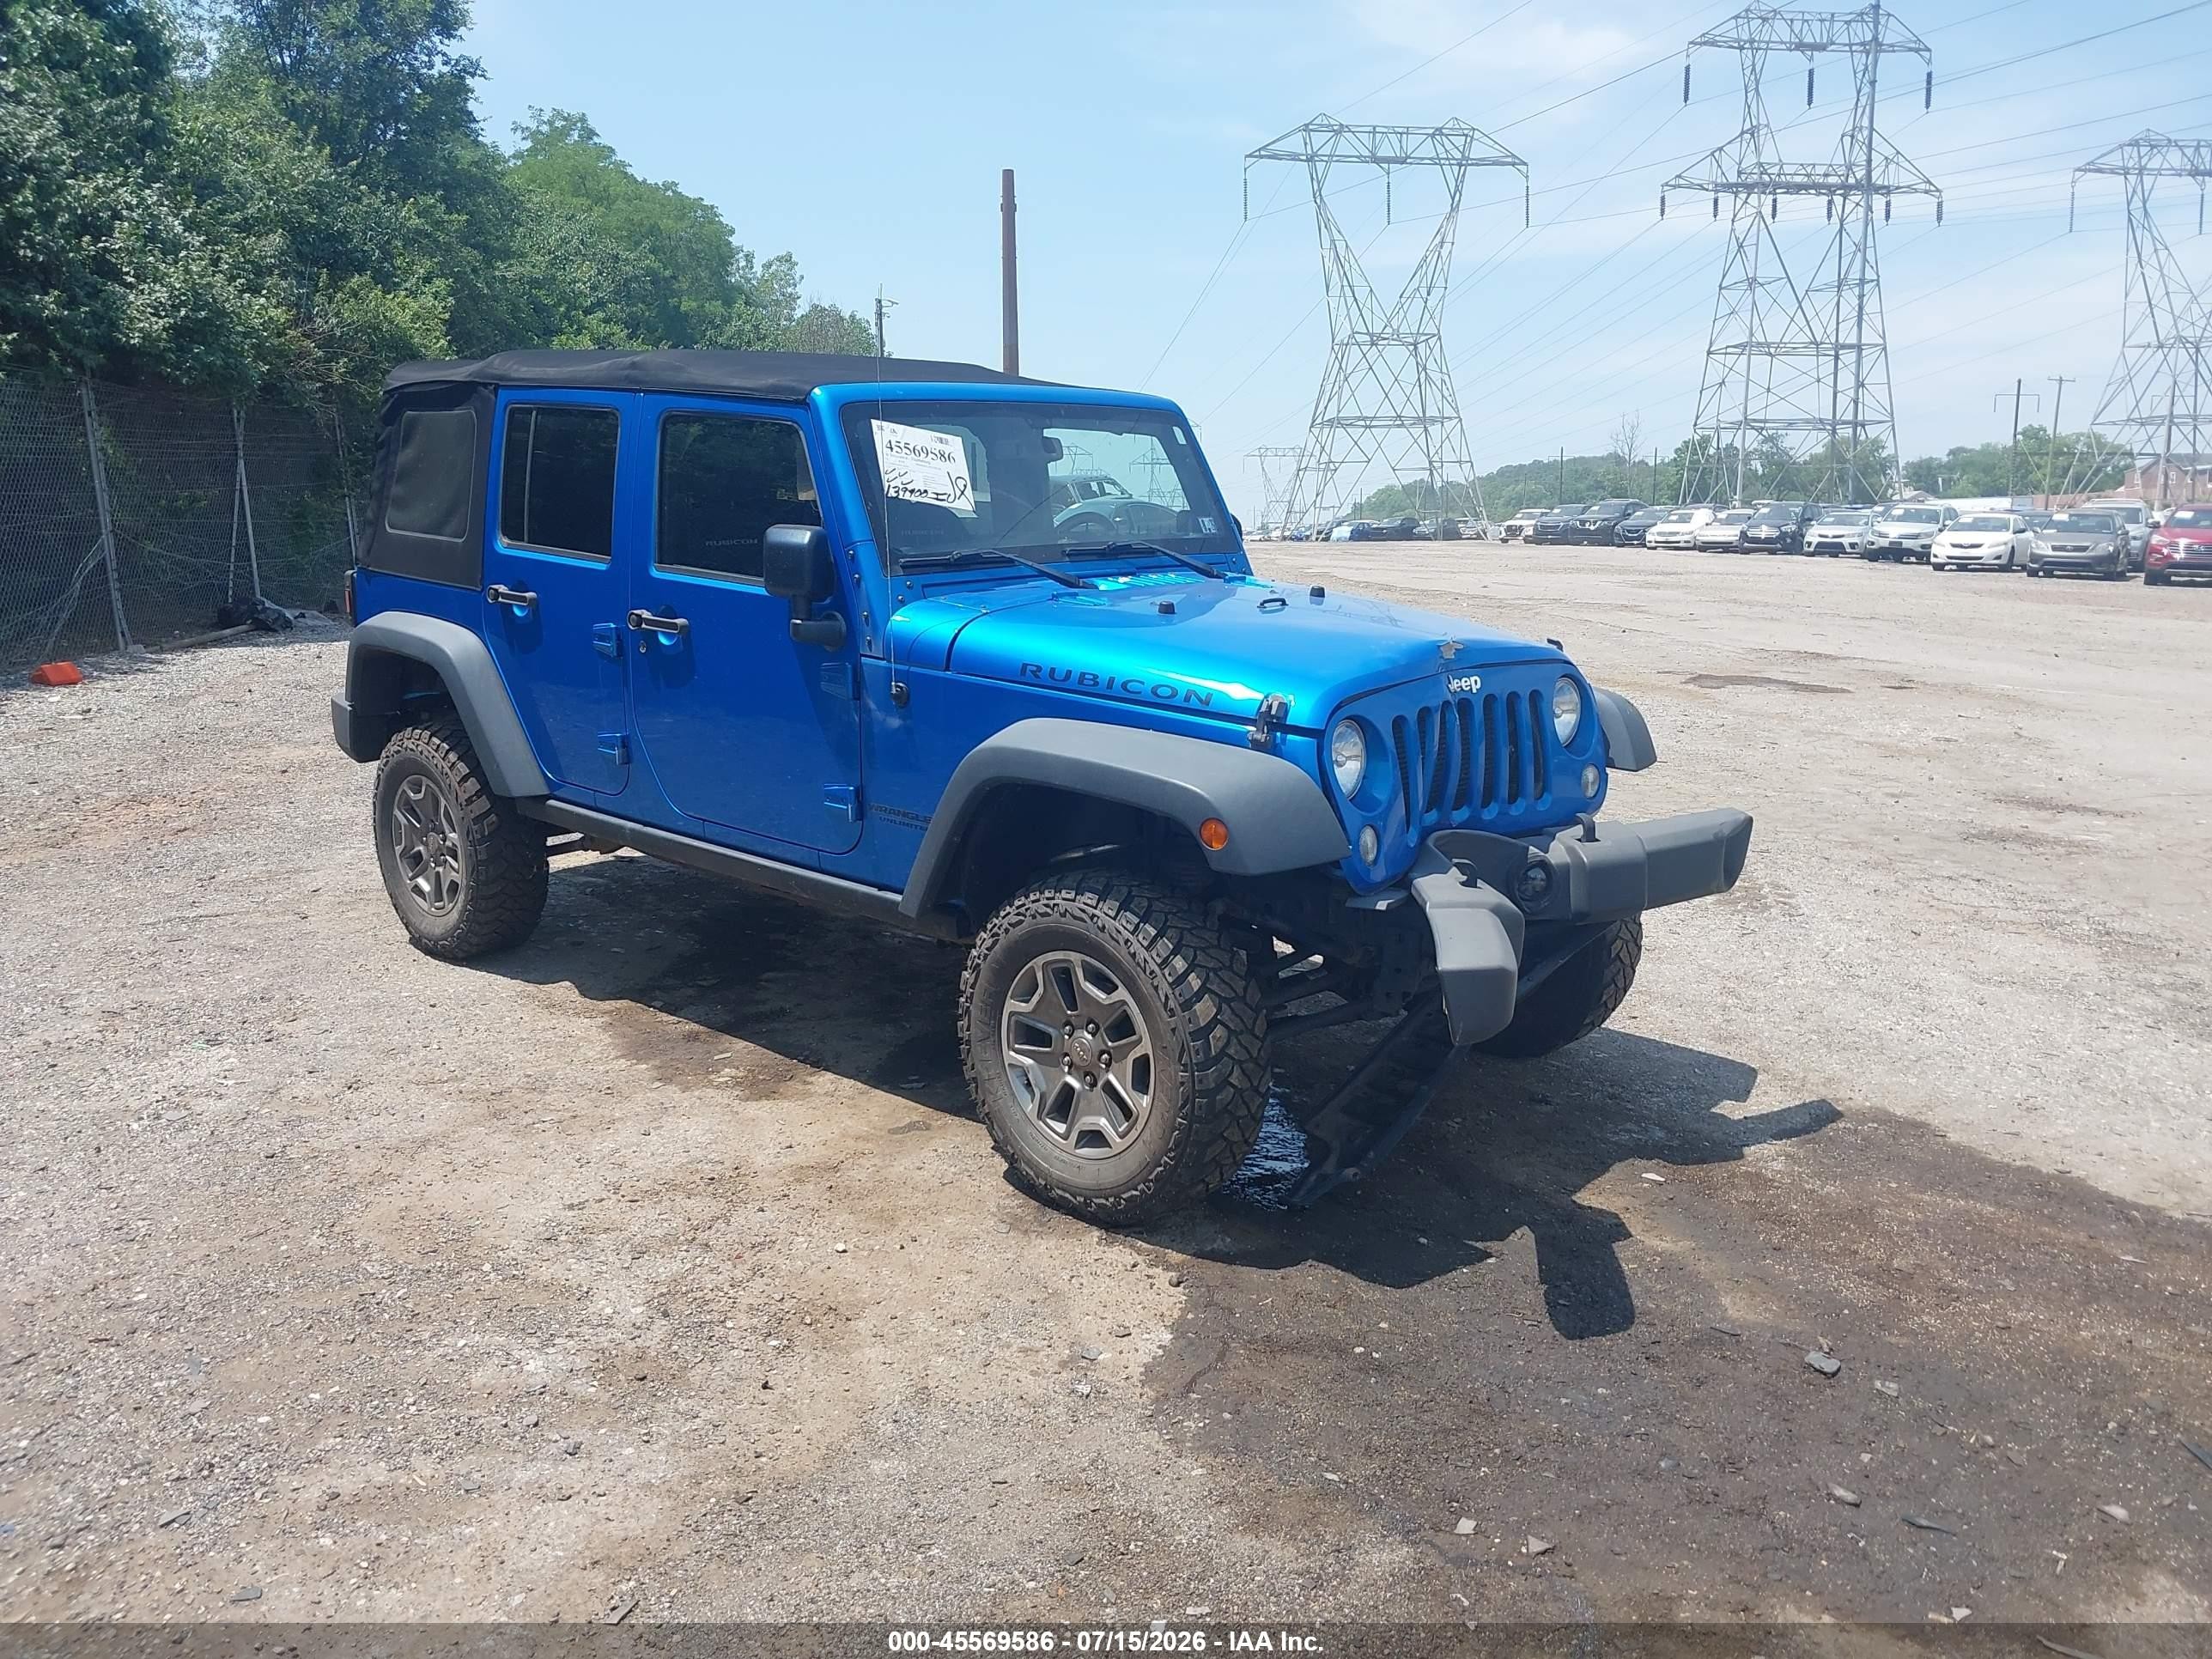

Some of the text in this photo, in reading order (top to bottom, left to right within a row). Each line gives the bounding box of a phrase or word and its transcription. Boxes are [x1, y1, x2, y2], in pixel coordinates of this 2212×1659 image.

[885, 439, 956, 464] 45569586
[1019, 663, 1214, 708] RUBICON
[1448, 674, 1482, 694] Jeep
